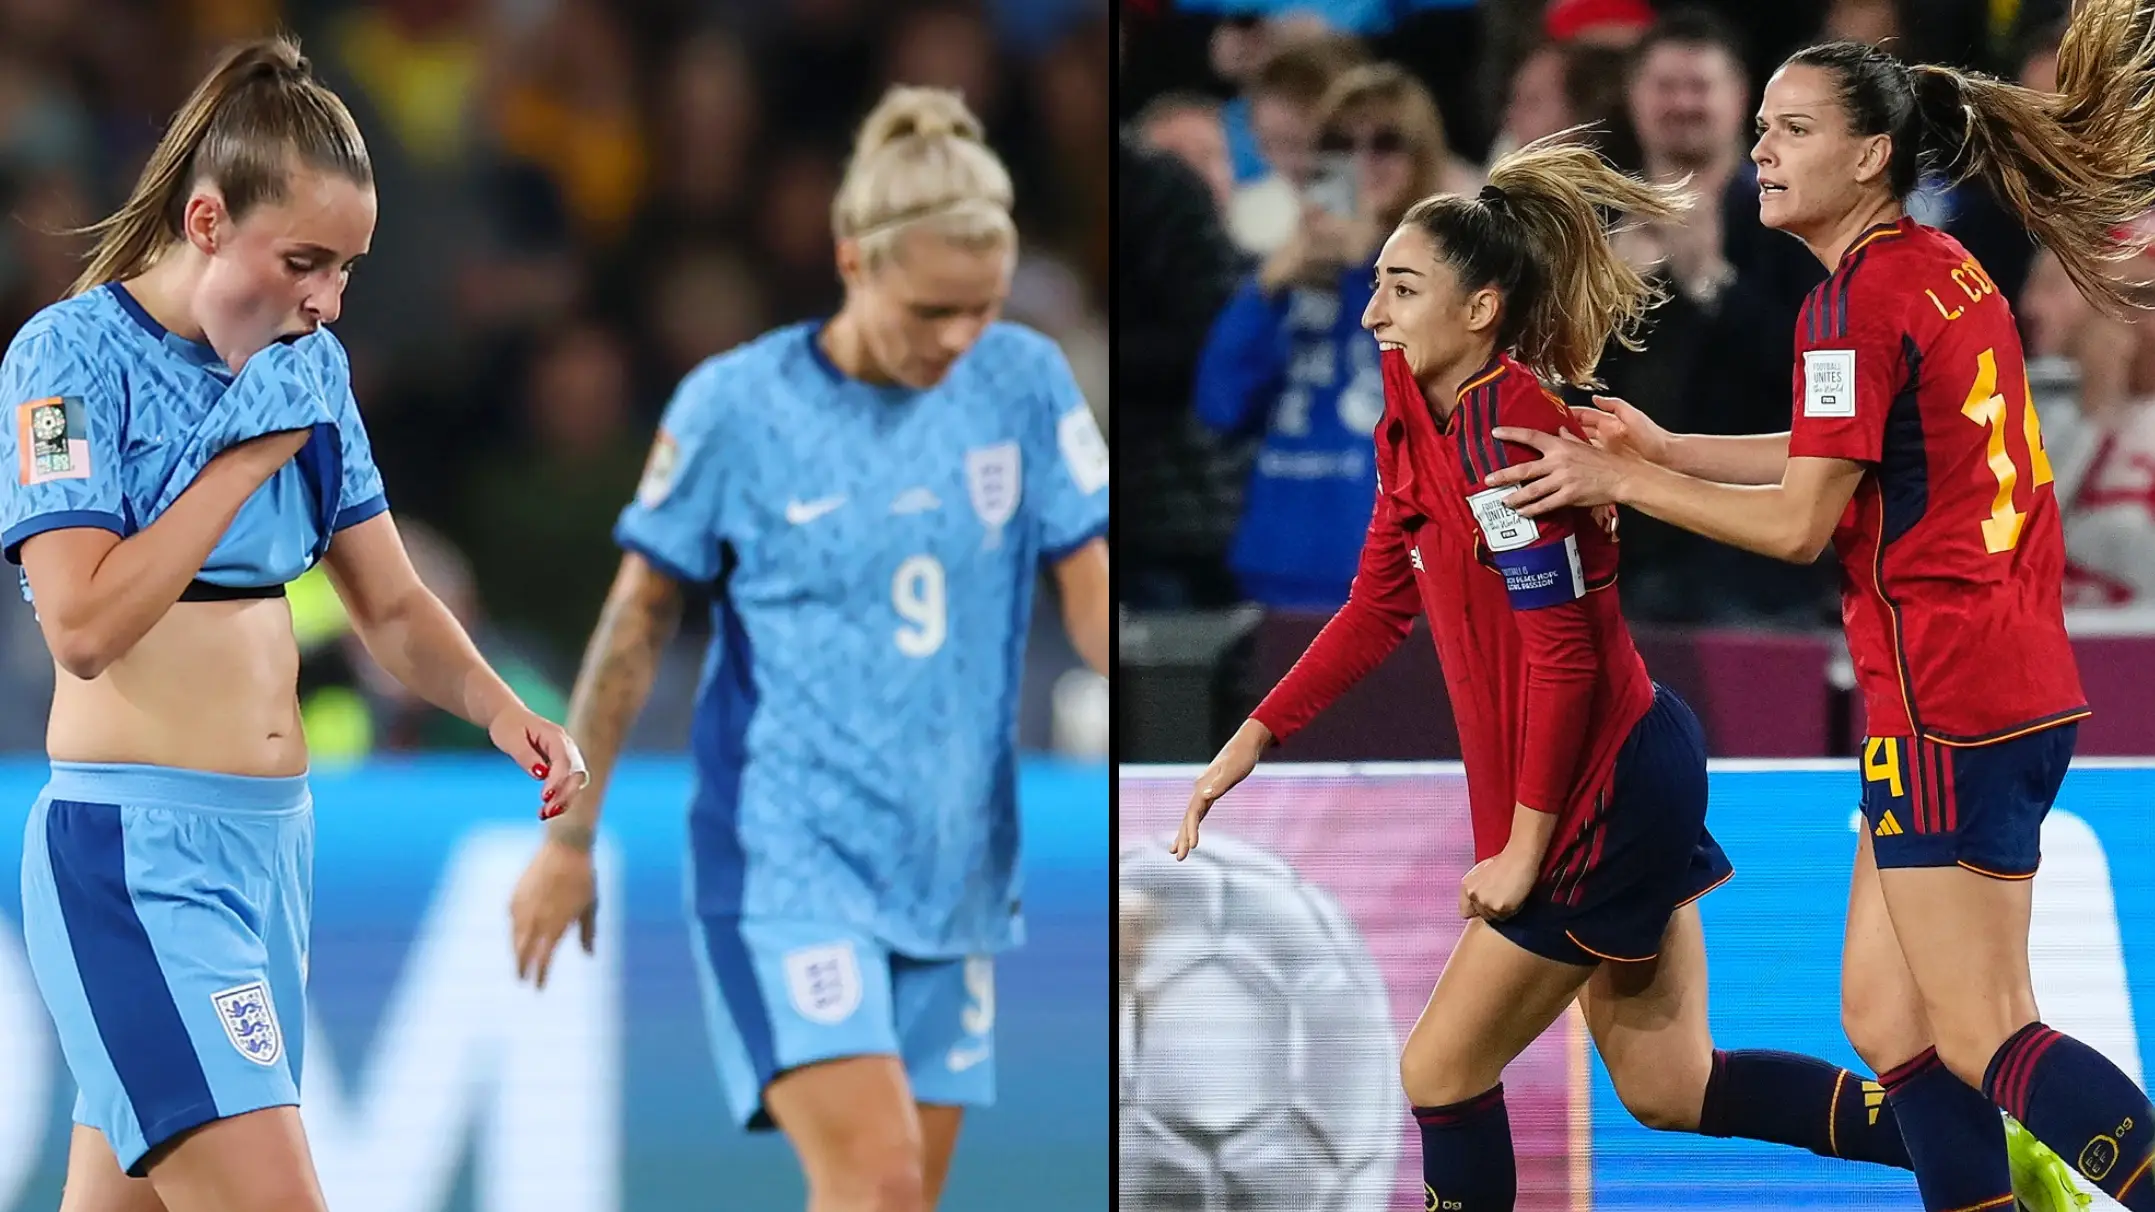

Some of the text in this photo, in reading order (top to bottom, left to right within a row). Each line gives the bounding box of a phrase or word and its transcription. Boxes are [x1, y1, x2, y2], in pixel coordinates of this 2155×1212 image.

[1924, 256, 1995, 320] L. CO
[1812, 362, 1841, 371] FOOTBALL
[1813, 371, 1842, 383] UNITES
[1484, 505, 1517, 522] UNITES
[1536, 570, 1559, 581] HOPE
[1521, 577, 1554, 590] PASSION
[891, 554, 947, 659] 9
[1864, 736, 1905, 798] 4
